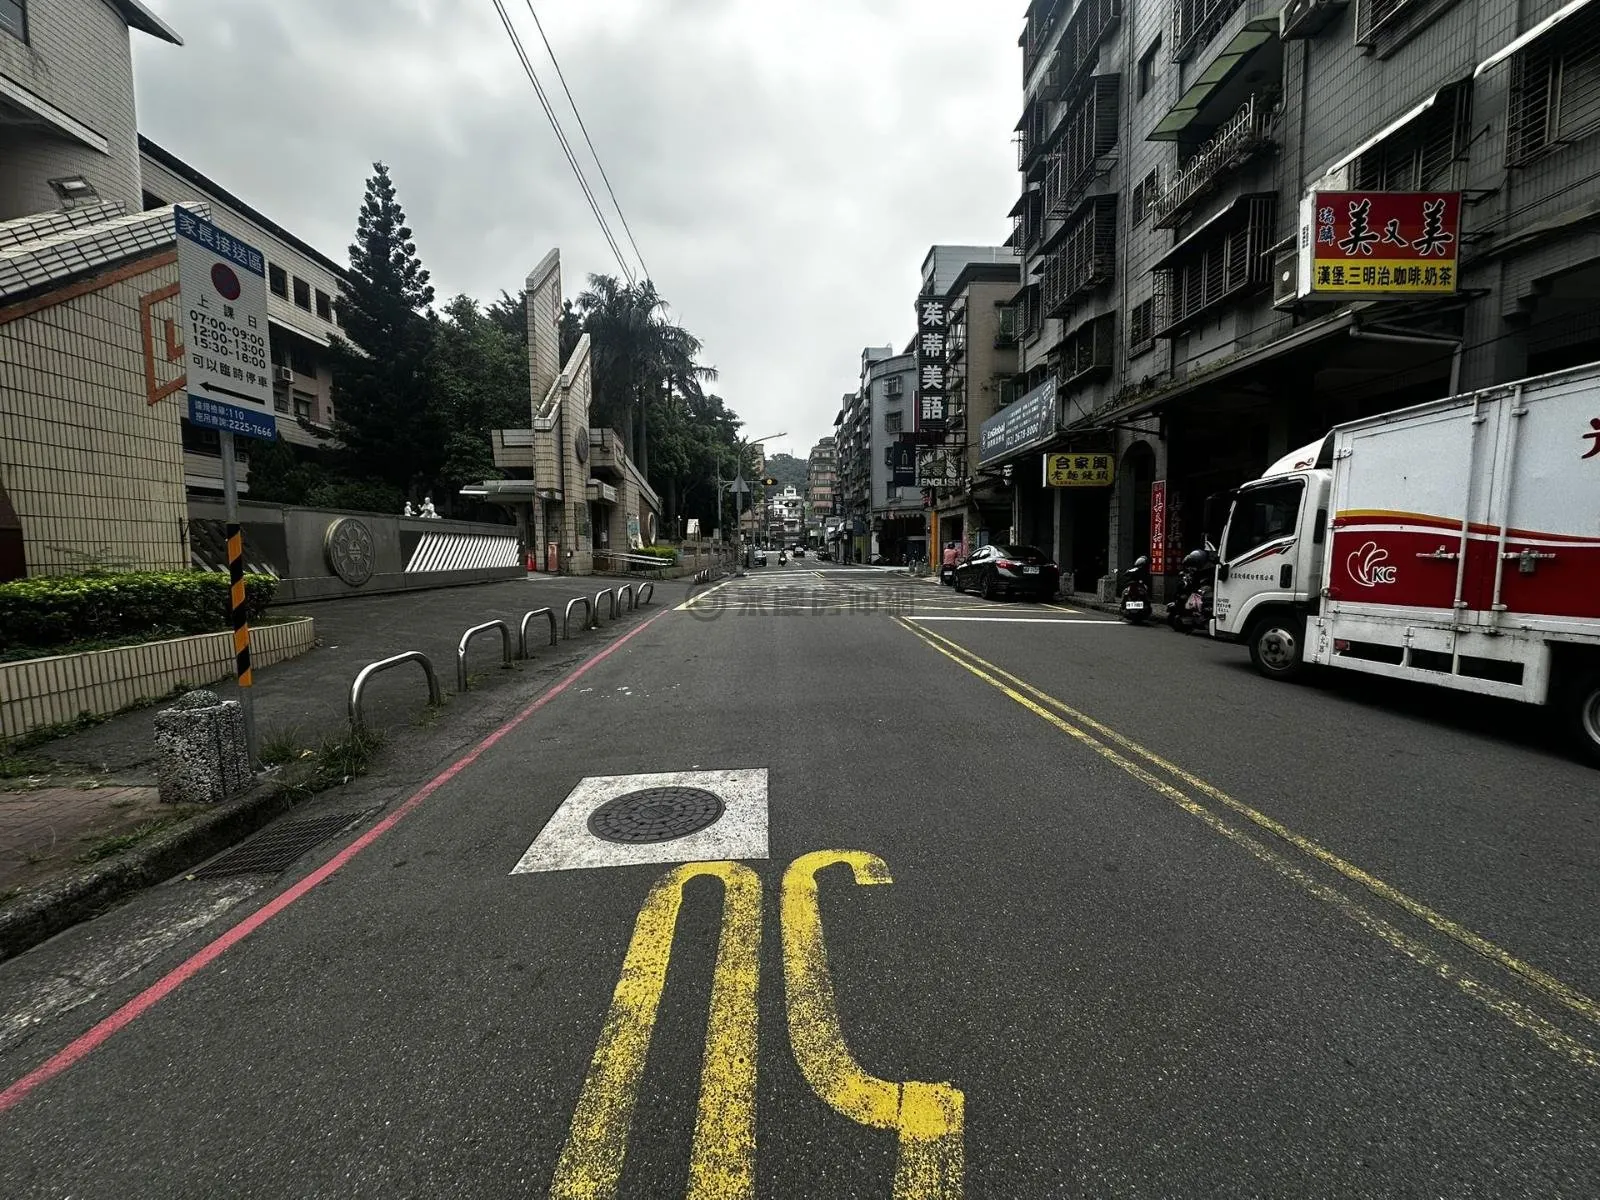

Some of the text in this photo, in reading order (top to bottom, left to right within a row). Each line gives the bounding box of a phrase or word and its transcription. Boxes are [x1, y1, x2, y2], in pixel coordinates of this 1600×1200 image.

[178, 213, 263, 273] 家長接送區
[1338, 198, 1454, 256] 美又美
[190, 309, 264, 347] 07:00-09:00
[192, 323, 265, 358] 12:00-13:00
[193, 335, 266, 369] 15:30-18:00
[921, 301, 944, 420] 茱蒂美語
[192, 353, 268, 389] 可以臨時停車
[1372, 566, 1397, 583] KC
